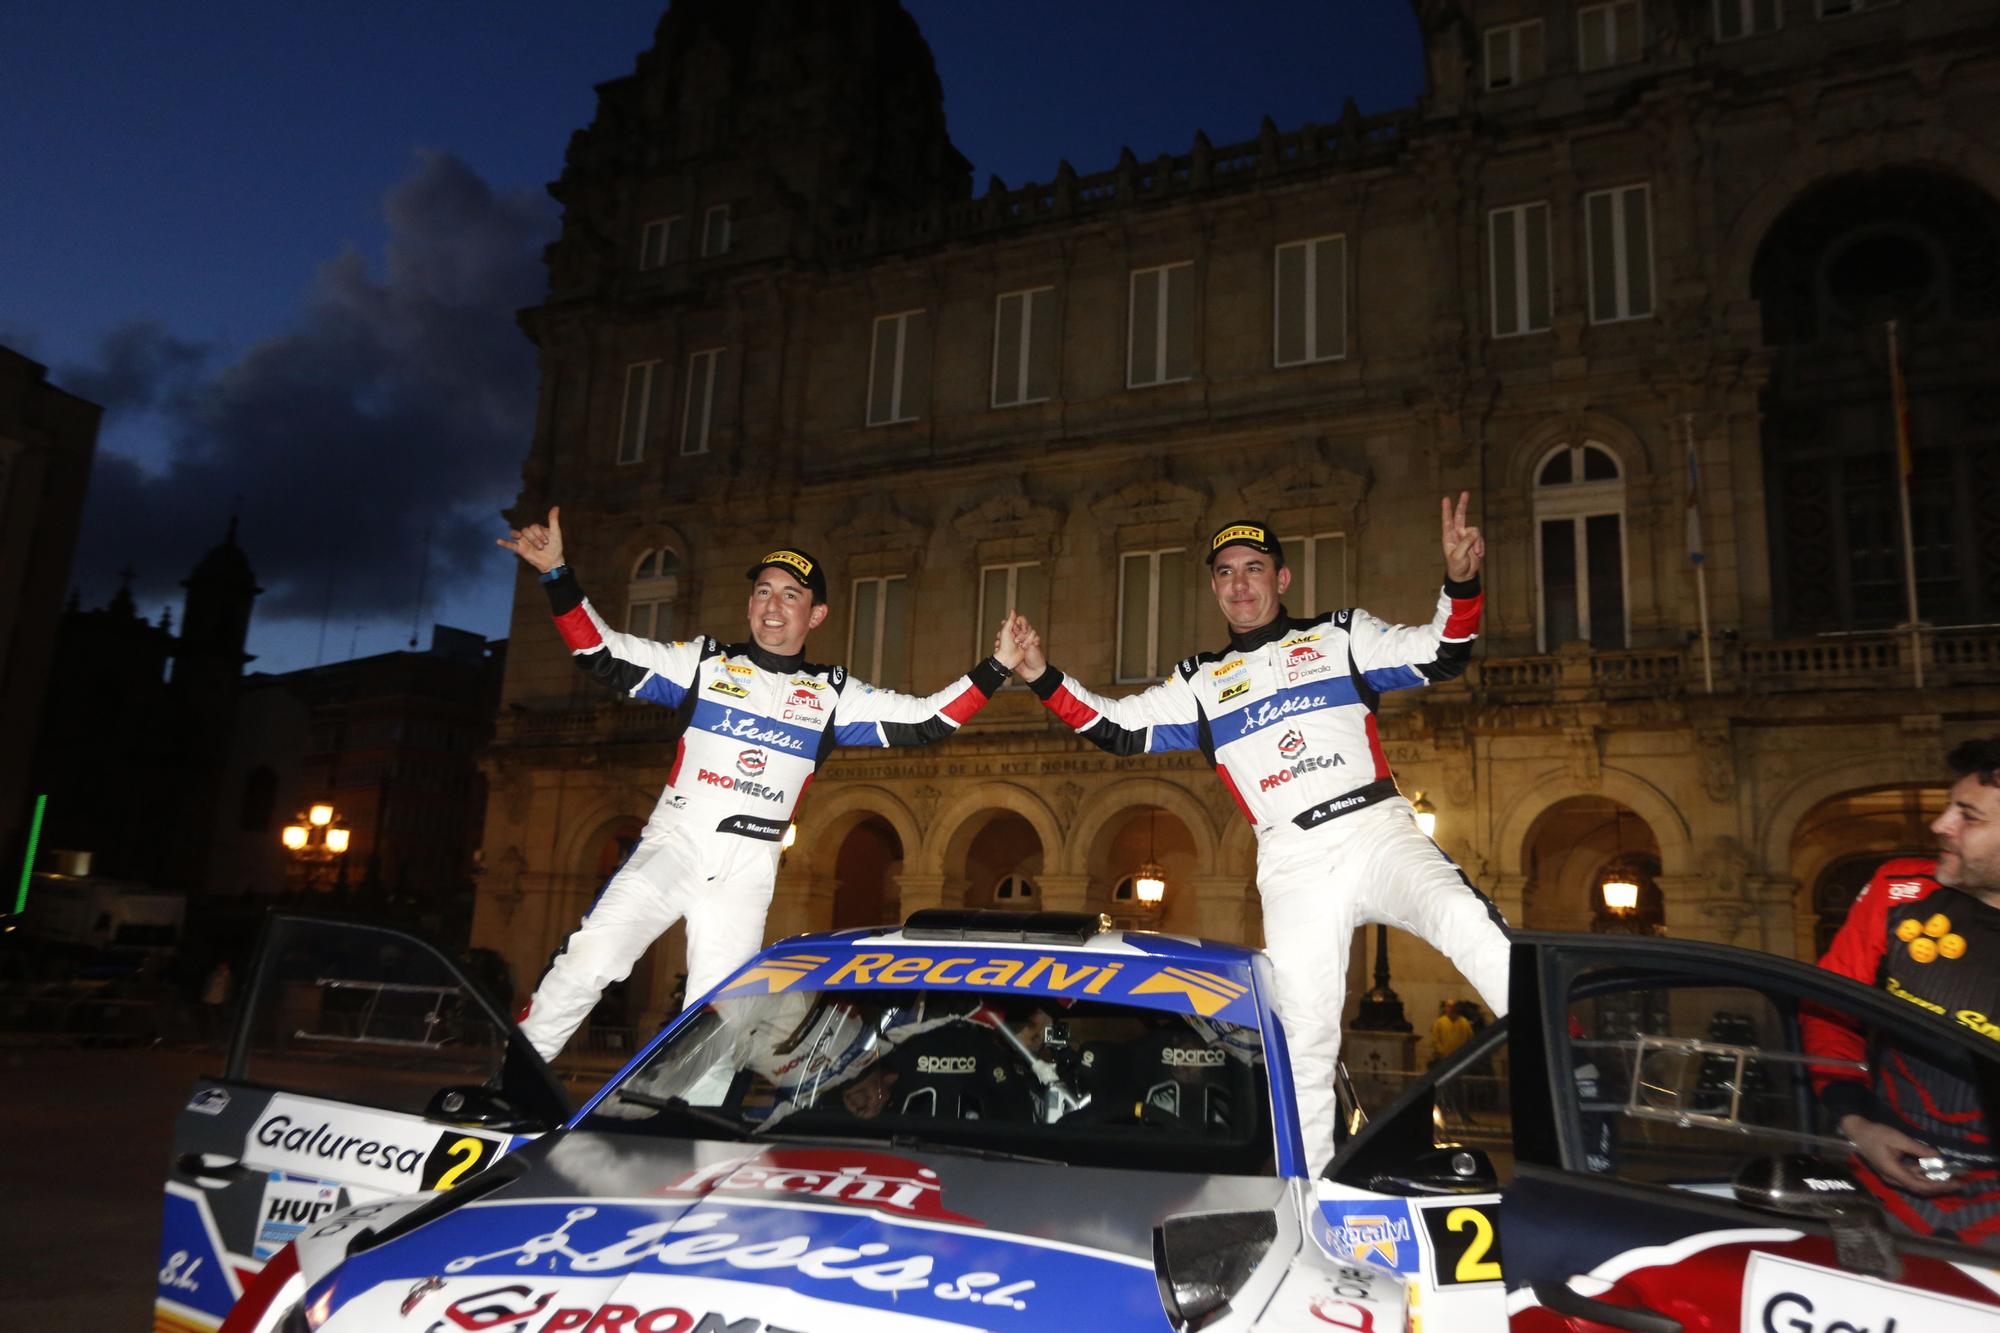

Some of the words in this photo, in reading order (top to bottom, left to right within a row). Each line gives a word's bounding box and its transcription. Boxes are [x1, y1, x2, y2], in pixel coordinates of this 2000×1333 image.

[1041, 760, 1089, 772] NOBLE
[1157, 756, 1196, 768] LEAL
[1260, 753, 1346, 792] PROMEGA
[697, 769, 785, 803] PROMEGA
[733, 821, 744, 829] A.
[1312, 810, 1327, 821] A.
[1330, 796, 1367, 812] Meira
[824, 951, 1125, 995] Recalvi
[256, 1114, 427, 1176] Galuresa
[434, 1137, 484, 1190] 2
[1446, 1207, 1502, 1282] 2
